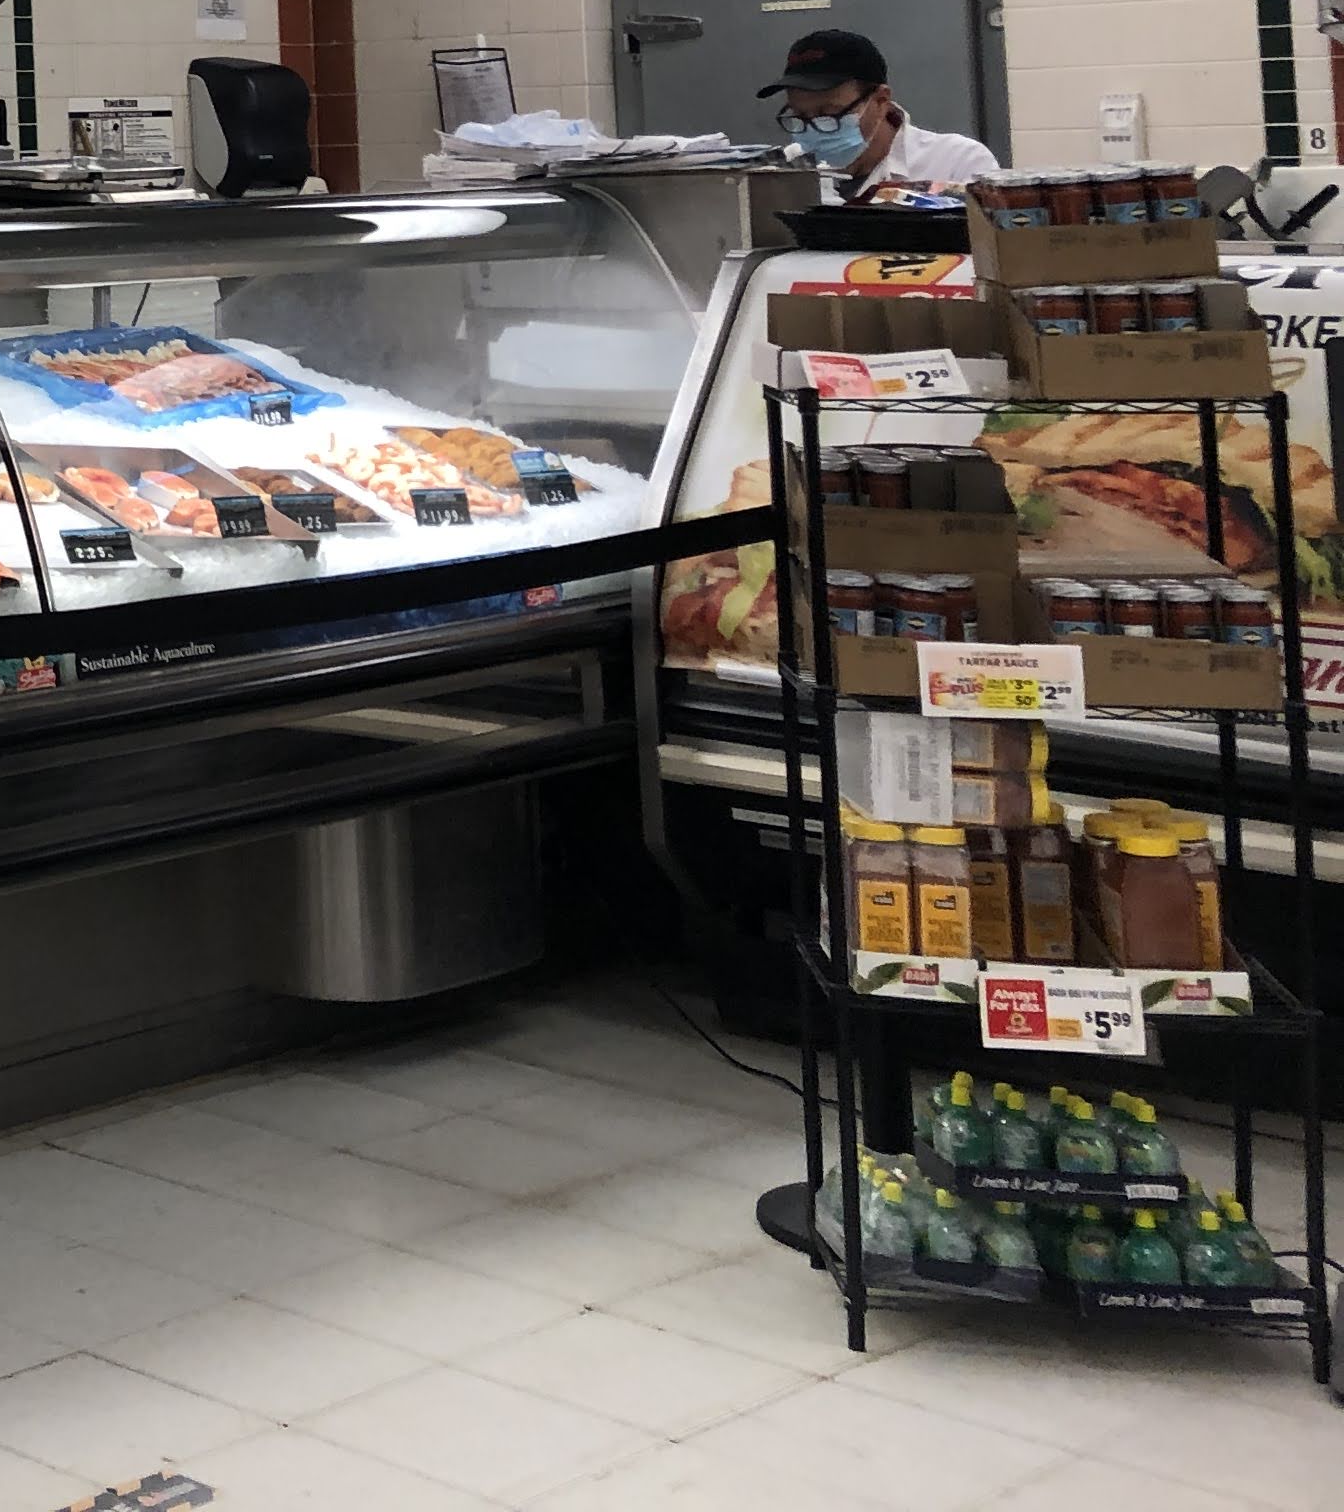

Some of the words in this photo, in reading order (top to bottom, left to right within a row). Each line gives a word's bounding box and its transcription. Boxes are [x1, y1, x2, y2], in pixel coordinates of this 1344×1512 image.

[1310, 127, 1326, 149] 8
[80, 644, 150, 673] Sustainable
[153, 641, 216, 664] Aquaculture
[1003, 657, 1040, 669] SAUCE
